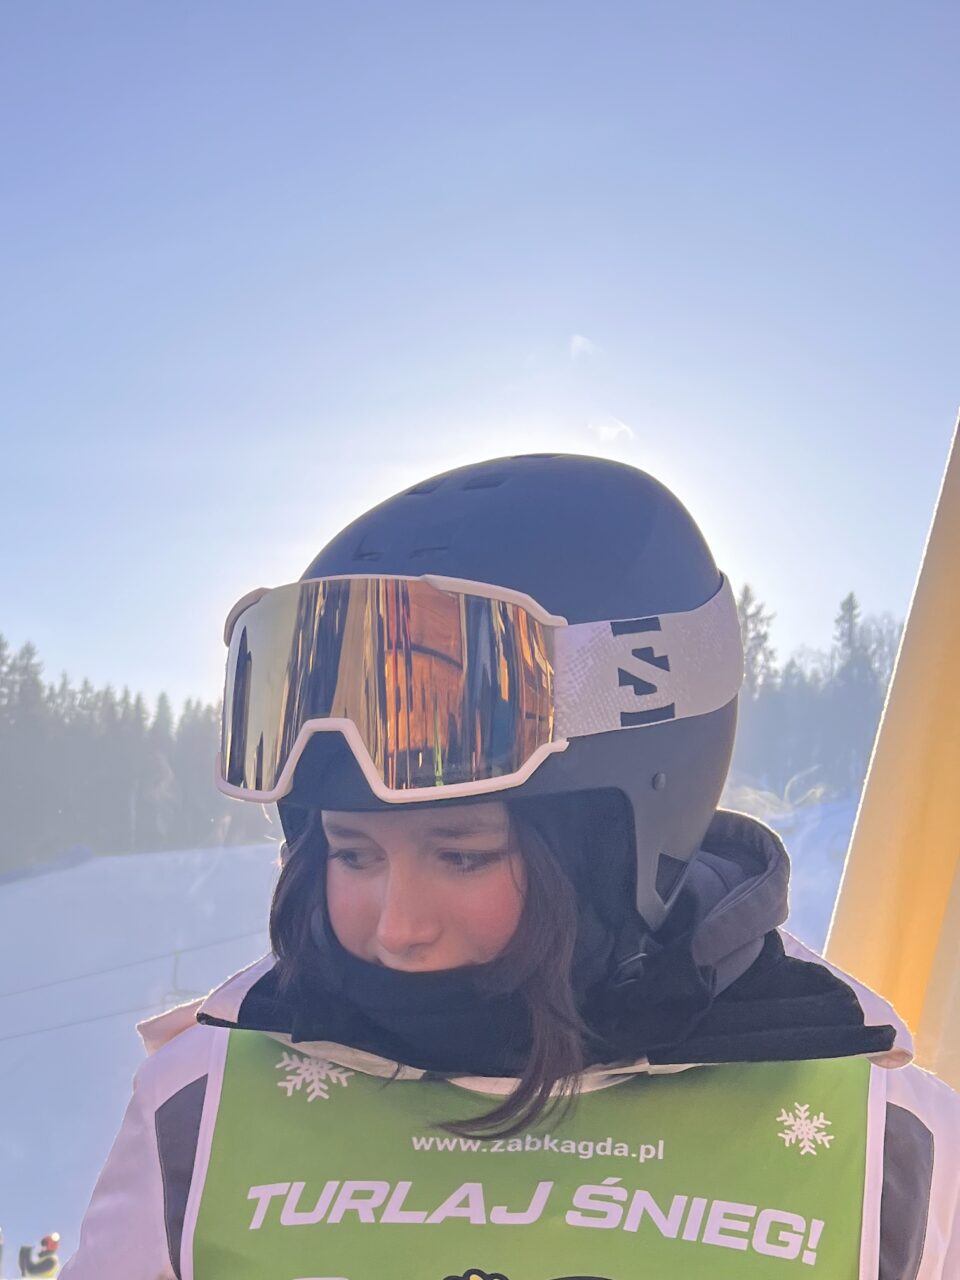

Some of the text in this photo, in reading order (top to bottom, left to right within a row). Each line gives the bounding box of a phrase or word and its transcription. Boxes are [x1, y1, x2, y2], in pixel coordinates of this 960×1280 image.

[411, 1134, 665, 1163] www.zabkagda.pl
[246, 1177, 825, 1266] TURLAJ ŚNIEG!
